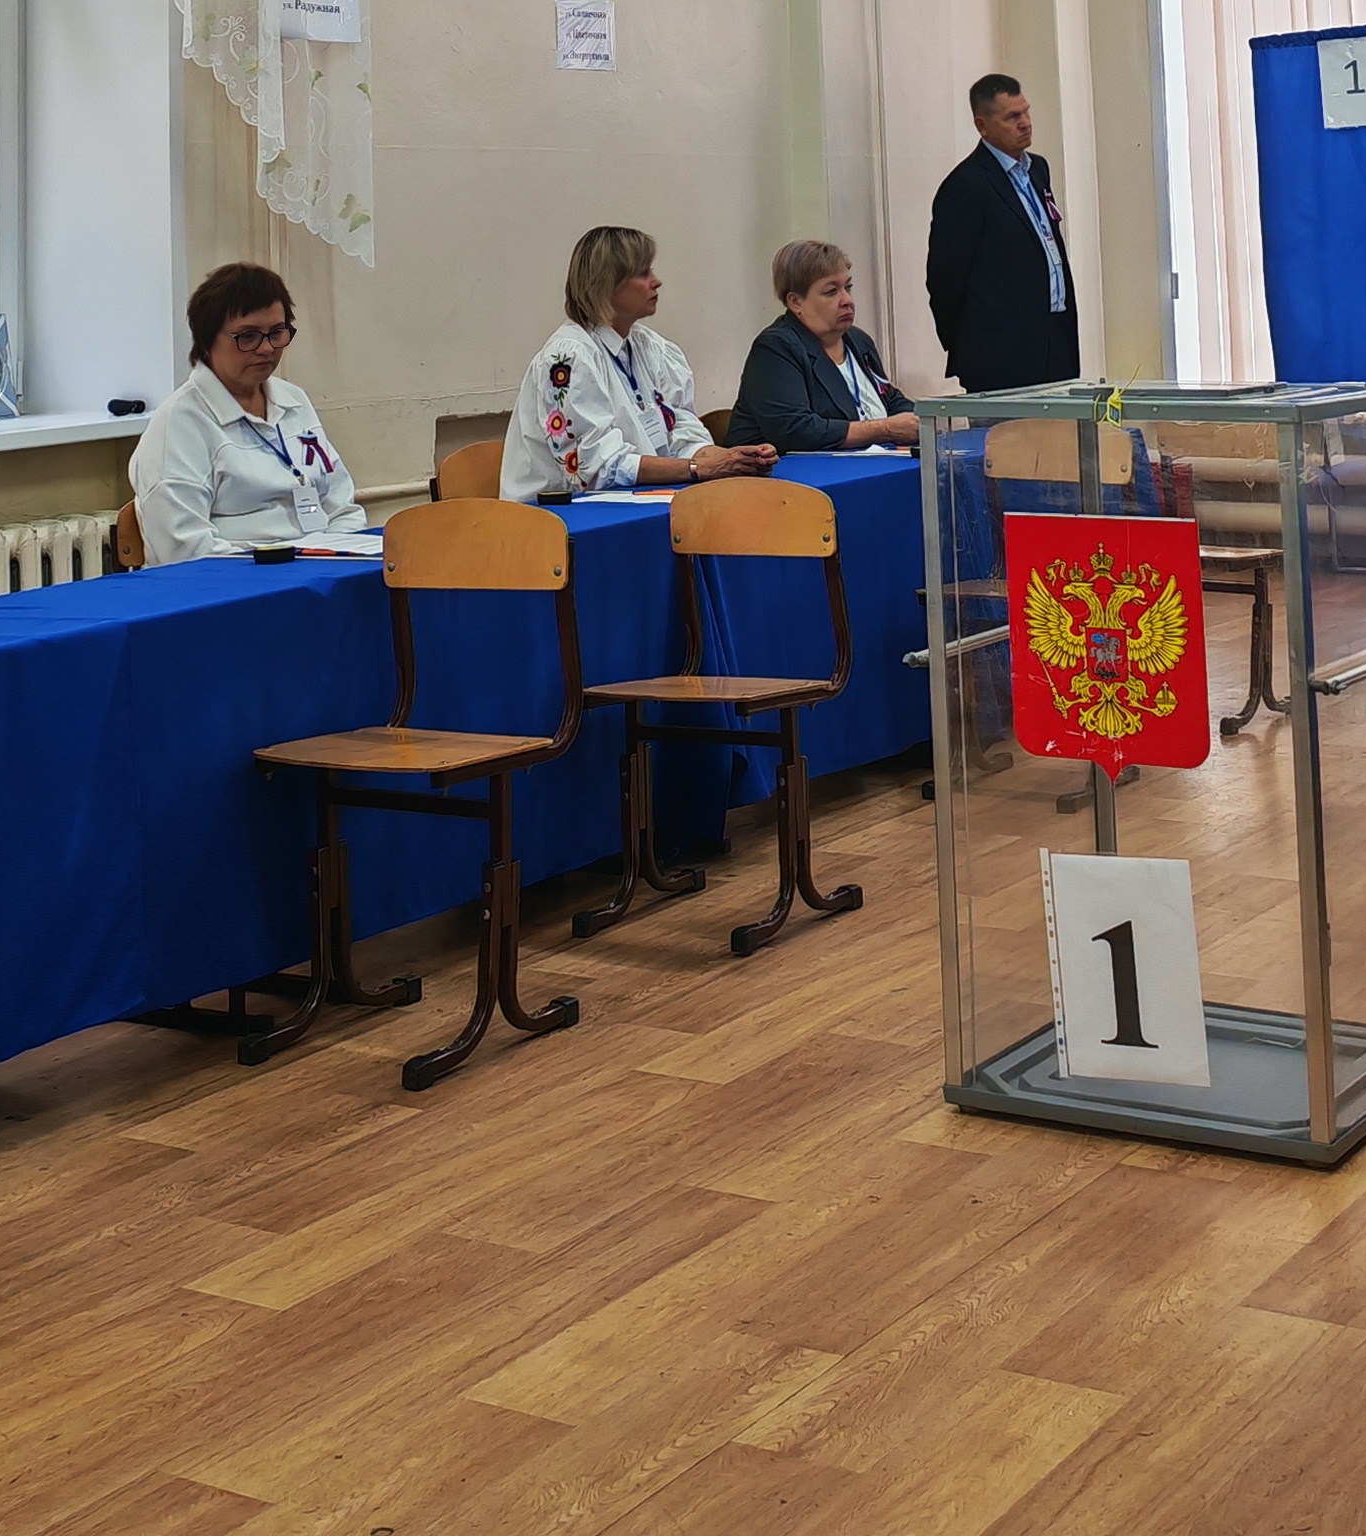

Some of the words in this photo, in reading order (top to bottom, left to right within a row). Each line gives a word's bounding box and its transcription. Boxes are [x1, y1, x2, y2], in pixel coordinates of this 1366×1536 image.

[283, 2, 293, 10] ул.
[295, 0, 341, 14] Радужная
[1344, 59, 1366, 95] 1
[1091, 920, 1159, 1049] 1
